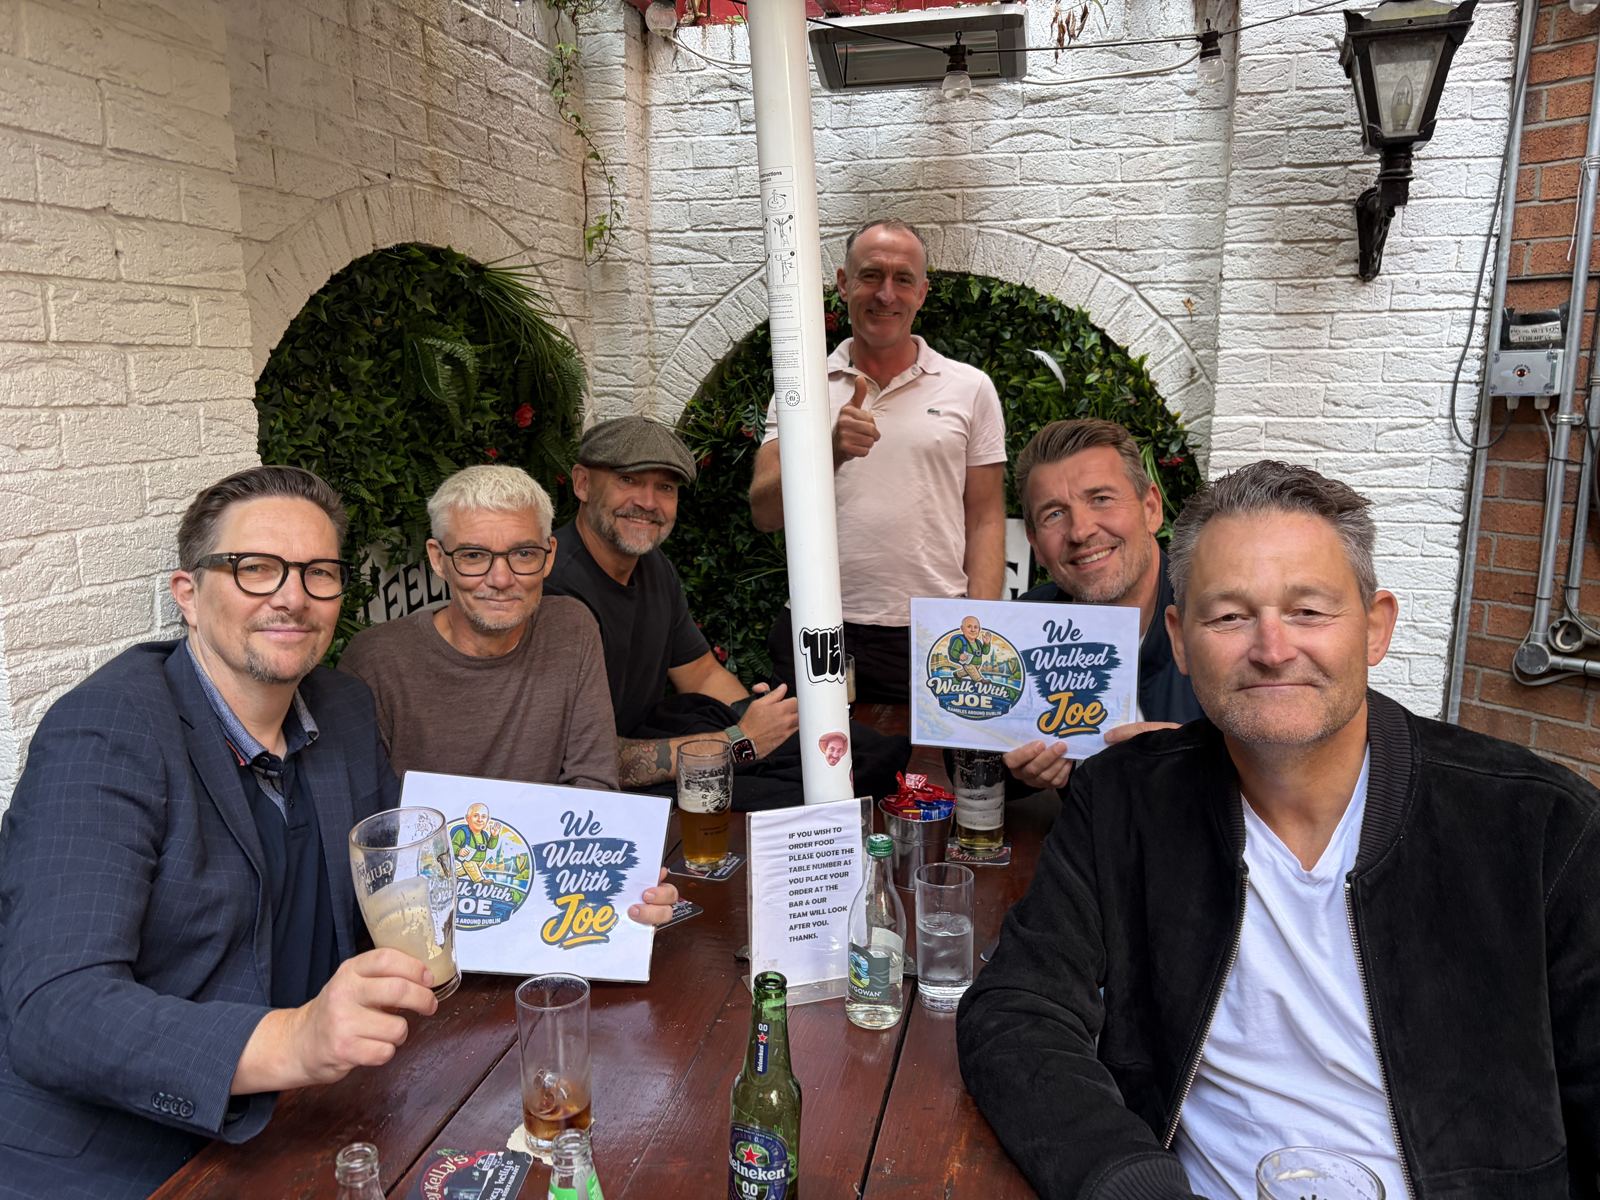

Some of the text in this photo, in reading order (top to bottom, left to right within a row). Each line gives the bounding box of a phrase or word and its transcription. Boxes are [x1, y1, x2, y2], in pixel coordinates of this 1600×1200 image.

[1042, 618, 1084, 644] We
[1030, 646, 1109, 671] Walked
[927, 677, 1010, 699] Walk With
[1045, 668, 1098, 692] With
[950, 693, 993, 709] JOE
[1038, 691, 1108, 733] Joe
[559, 809, 603, 837] We
[796, 830, 812, 838] YOU
[813, 828, 831, 836] WISH
[788, 838, 835, 850] ORDER FOOD
[542, 841, 629, 869] Walked
[788, 847, 855, 862] PLEASE QUOTE THE
[788, 864, 811, 873] TABLE
[811, 860, 842, 870] NUMBER
[555, 868, 612, 894] With
[788, 871, 849, 885] YOU PLACE YOUR
[456, 881, 472, 896] lk
[472, 882, 513, 902] With
[788, 887, 813, 897] ORDER
[825, 884, 839, 892] THE
[456, 897, 493, 916] OE
[788, 900, 804, 909] BAR
[811, 896, 827, 905] OUR
[542, 893, 618, 944] Joe
[788, 905, 848, 919] TEAM WILL LOOK
[459, 916, 501, 925] AROUND DUBLIN
[788, 919, 830, 931] AFTER YOU.
[788, 932, 819, 943] THANKS.
